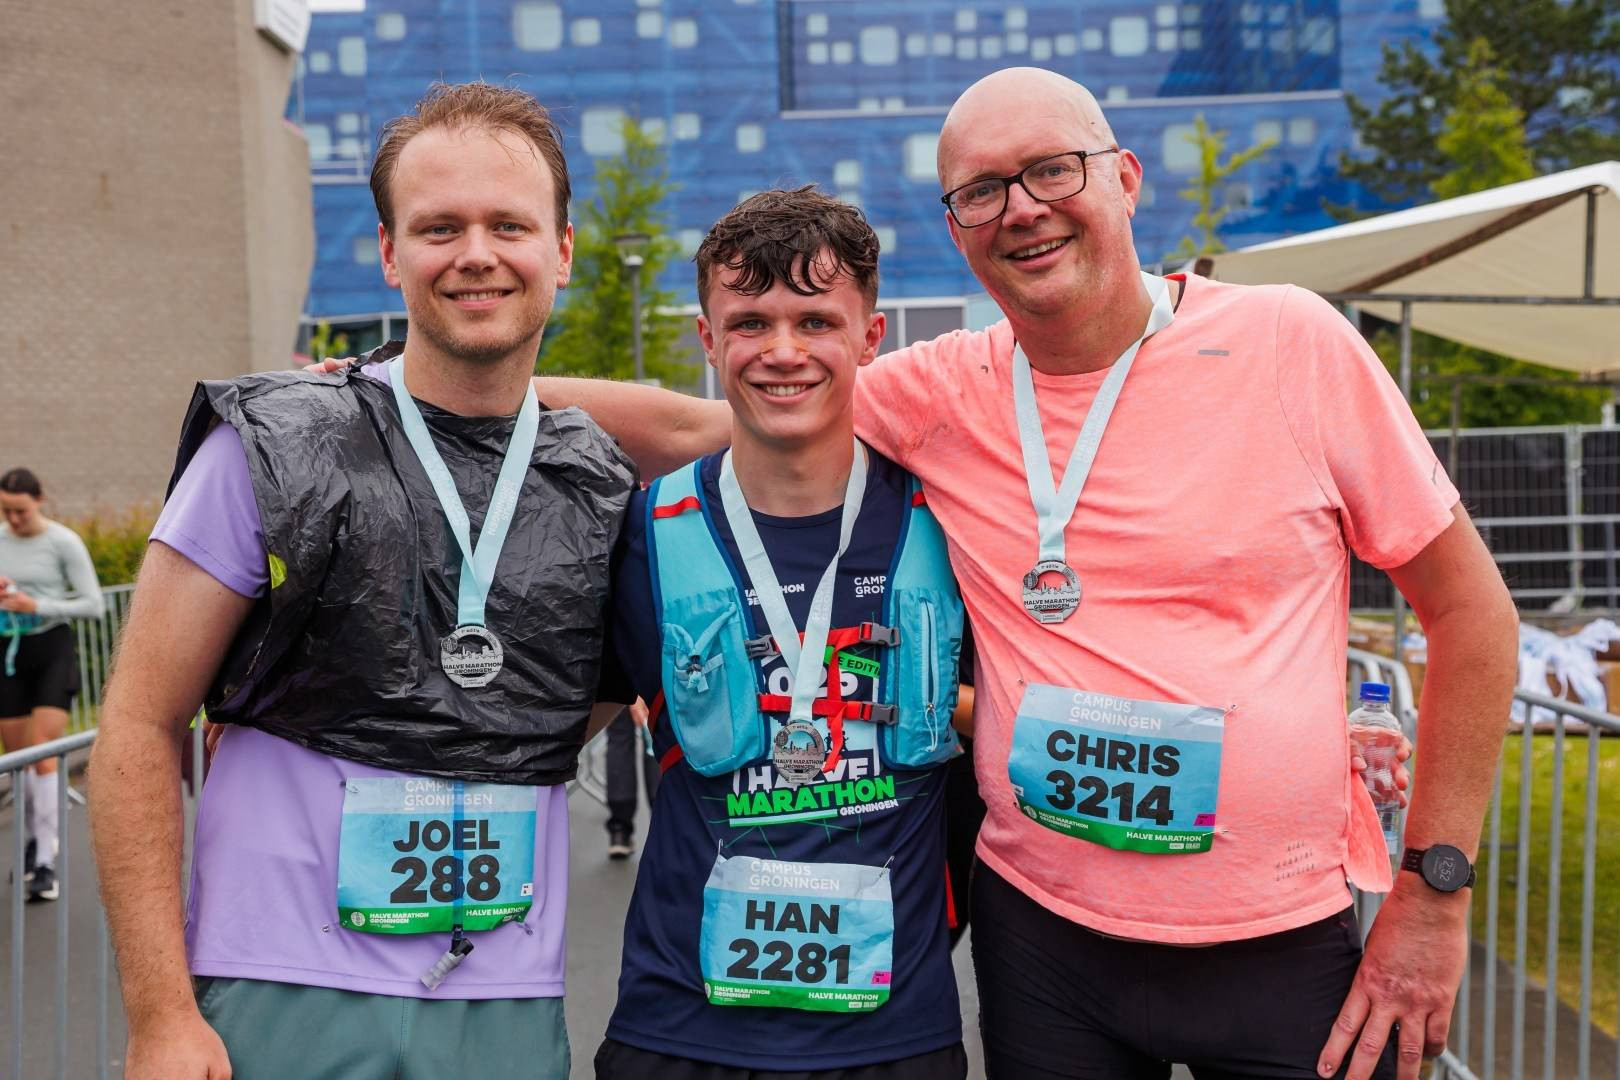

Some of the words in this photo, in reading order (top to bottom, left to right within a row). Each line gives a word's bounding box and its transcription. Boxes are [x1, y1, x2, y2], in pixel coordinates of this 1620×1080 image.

[853, 575, 887, 586] CAMP
[847, 659, 880, 675] EDITI
[1073, 692, 1132, 713] CAMPUS
[1070, 706, 1162, 730] GRONINGEN
[1046, 729, 1181, 777] CHRIS
[727, 776, 895, 816] MARATHON
[1045, 769, 1174, 826] 3214
[840, 799, 899, 816] GRONINGEN
[392, 820, 500, 852] JOEL
[1126, 832, 1153, 841] HALVE
[1155, 833, 1202, 842] MARATHON
[390, 854, 501, 903] 288
[751, 861, 812, 875] CAMPUS
[750, 874, 840, 891] GRONINGEN
[466, 909, 492, 917] HALVE
[745, 899, 840, 935] HAN
[726, 938, 852, 984] 2281
[808, 991, 833, 1000] HALVE
[834, 992, 879, 1001] MARATHON
